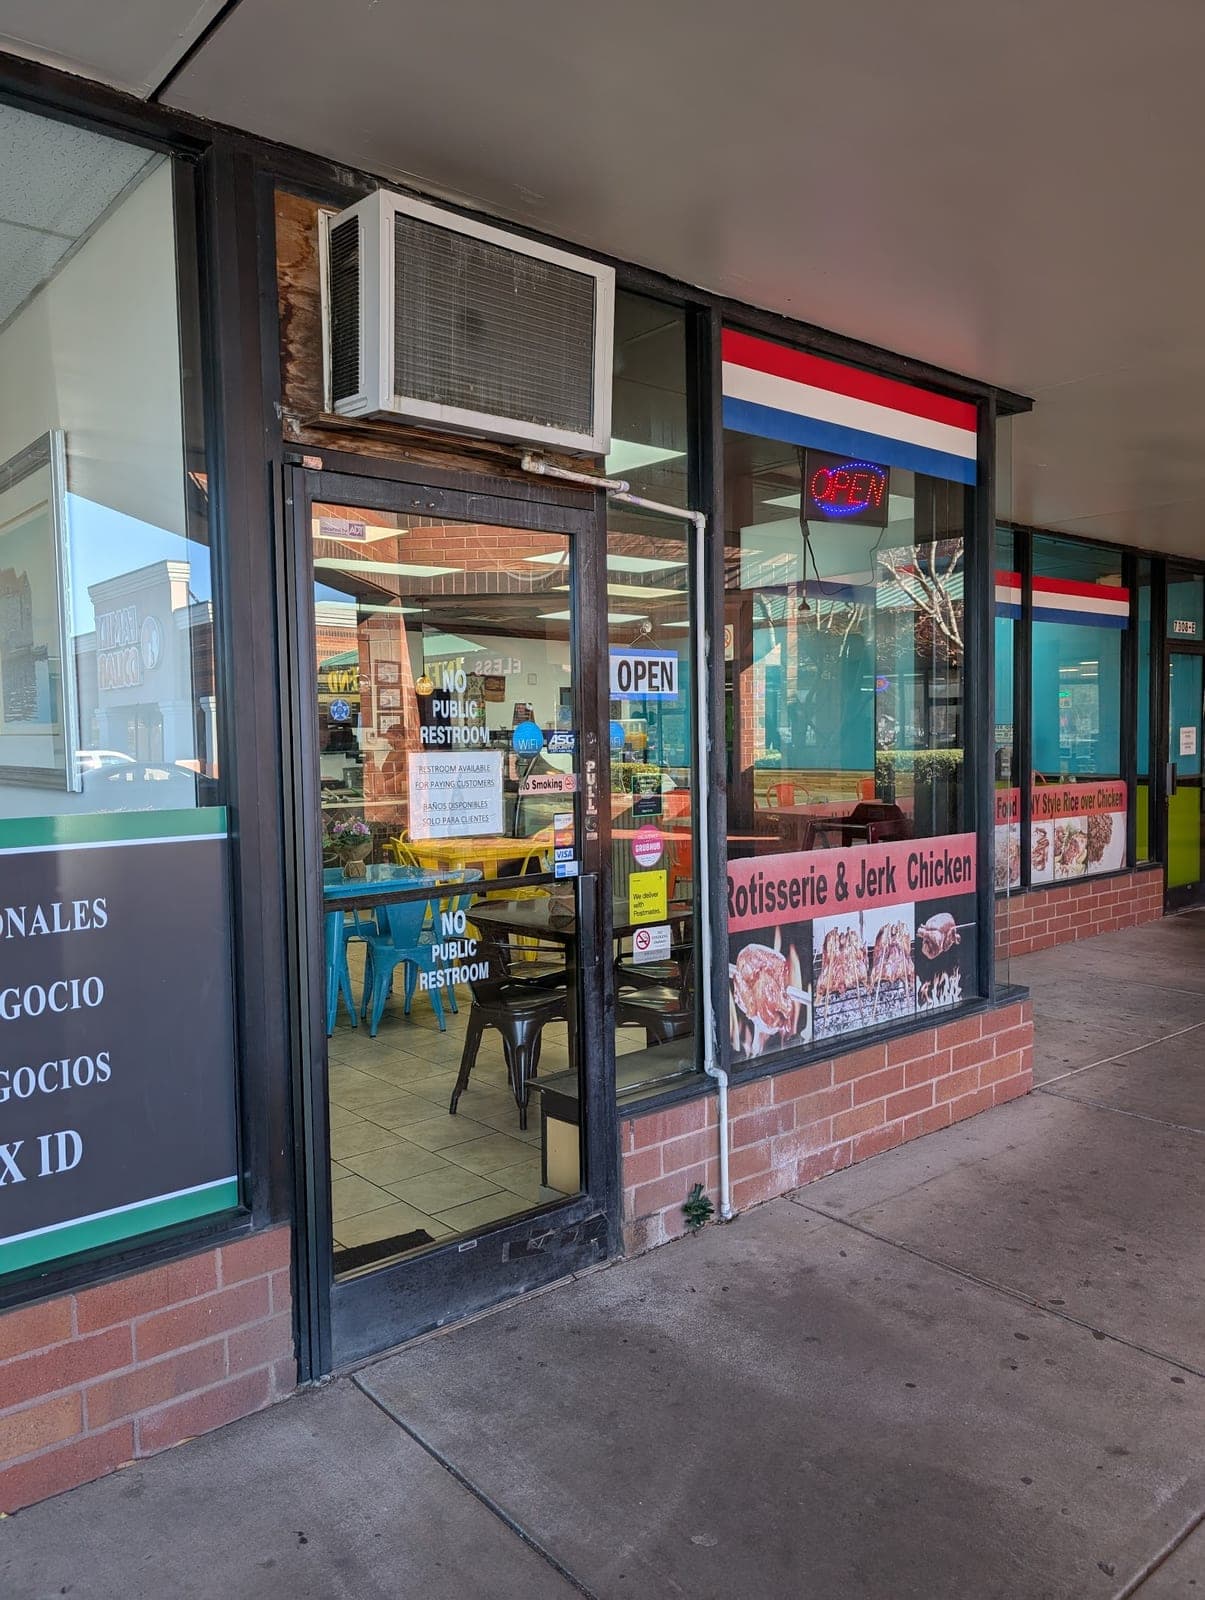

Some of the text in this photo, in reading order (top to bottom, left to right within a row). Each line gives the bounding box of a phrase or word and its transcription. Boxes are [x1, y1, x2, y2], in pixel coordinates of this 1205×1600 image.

[811, 467, 885, 507] OPEN
[442, 669, 467, 694] NO
[617, 659, 674, 692] OPEN
[432, 699, 479, 719] PUBLIC
[420, 726, 490, 745] RESTROOM
[548, 734, 575, 745] ASG
[418, 764, 491, 773] RESTROOM AVAILABLE
[415, 779, 495, 790] FOR PAYING CUSTOMERS
[531, 778, 563, 790] Smoking
[585, 760, 597, 811] PULL
[1042, 792, 1061, 818] Style
[1063, 791, 1080, 812] Rice
[1081, 794, 1096, 810] over
[1097, 788, 1123, 809] Chicken
[442, 815, 460, 824] PARA
[461, 814, 490, 824] CLIENTES
[556, 850, 573, 860] VISA
[642, 891, 659, 899] deliver
[727, 849, 972, 918] Rotisserie & Jerk Chicken
[441, 910, 467, 936] NO
[431, 938, 477, 963] PUBLIC
[419, 961, 489, 991] RESTROOM
[36, 1129, 83, 1178] ID
